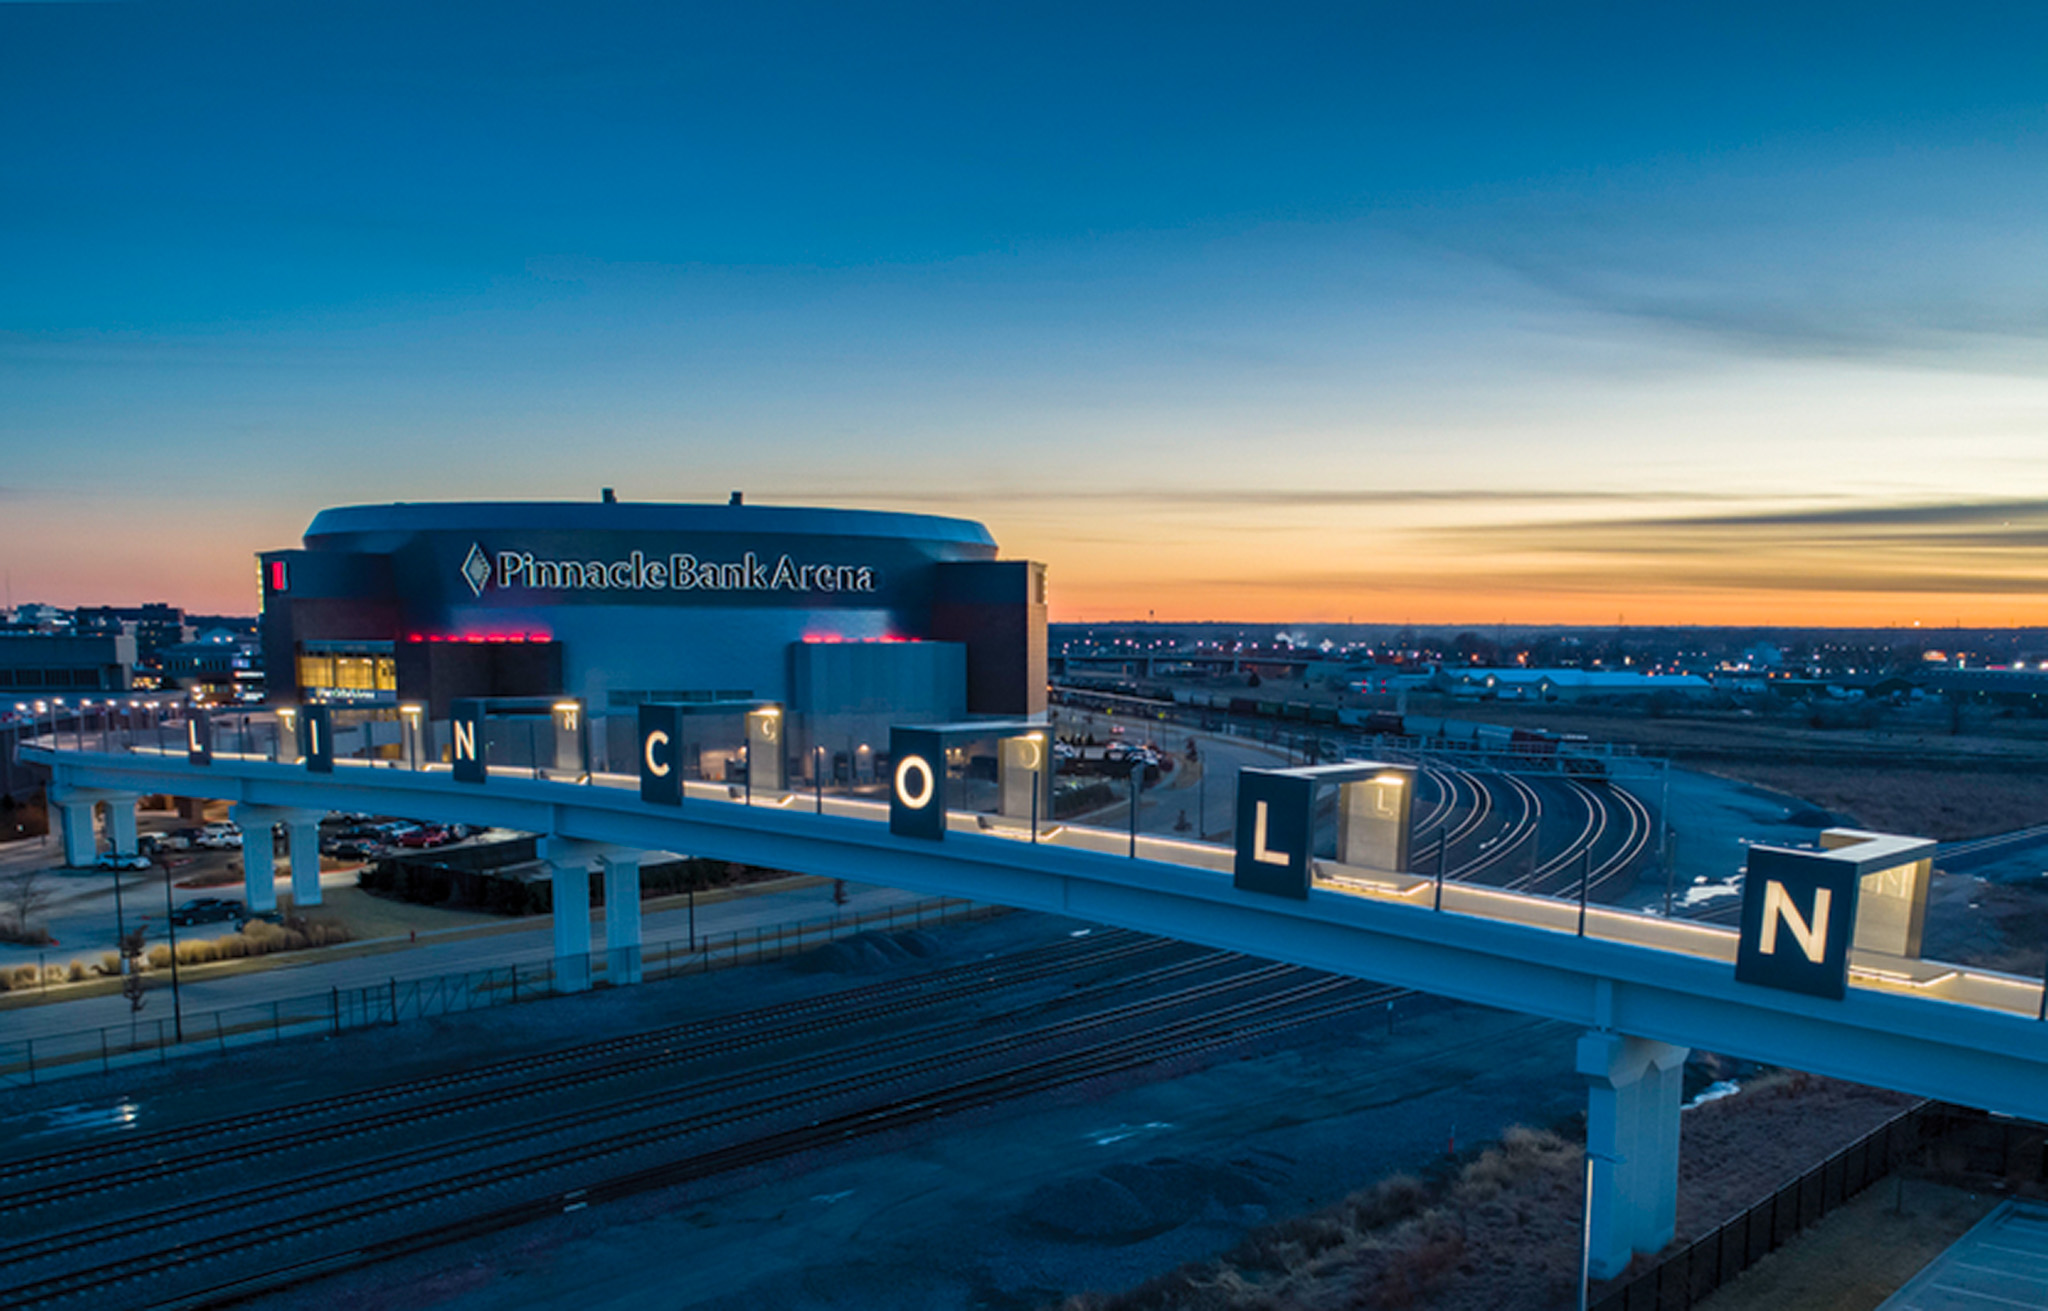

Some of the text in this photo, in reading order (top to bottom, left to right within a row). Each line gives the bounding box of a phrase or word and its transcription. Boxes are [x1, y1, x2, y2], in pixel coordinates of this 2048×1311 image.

[497, 551, 876, 592] Pinnacle Bank Arena
[189, 719, 1831, 963] L I N C O L N
